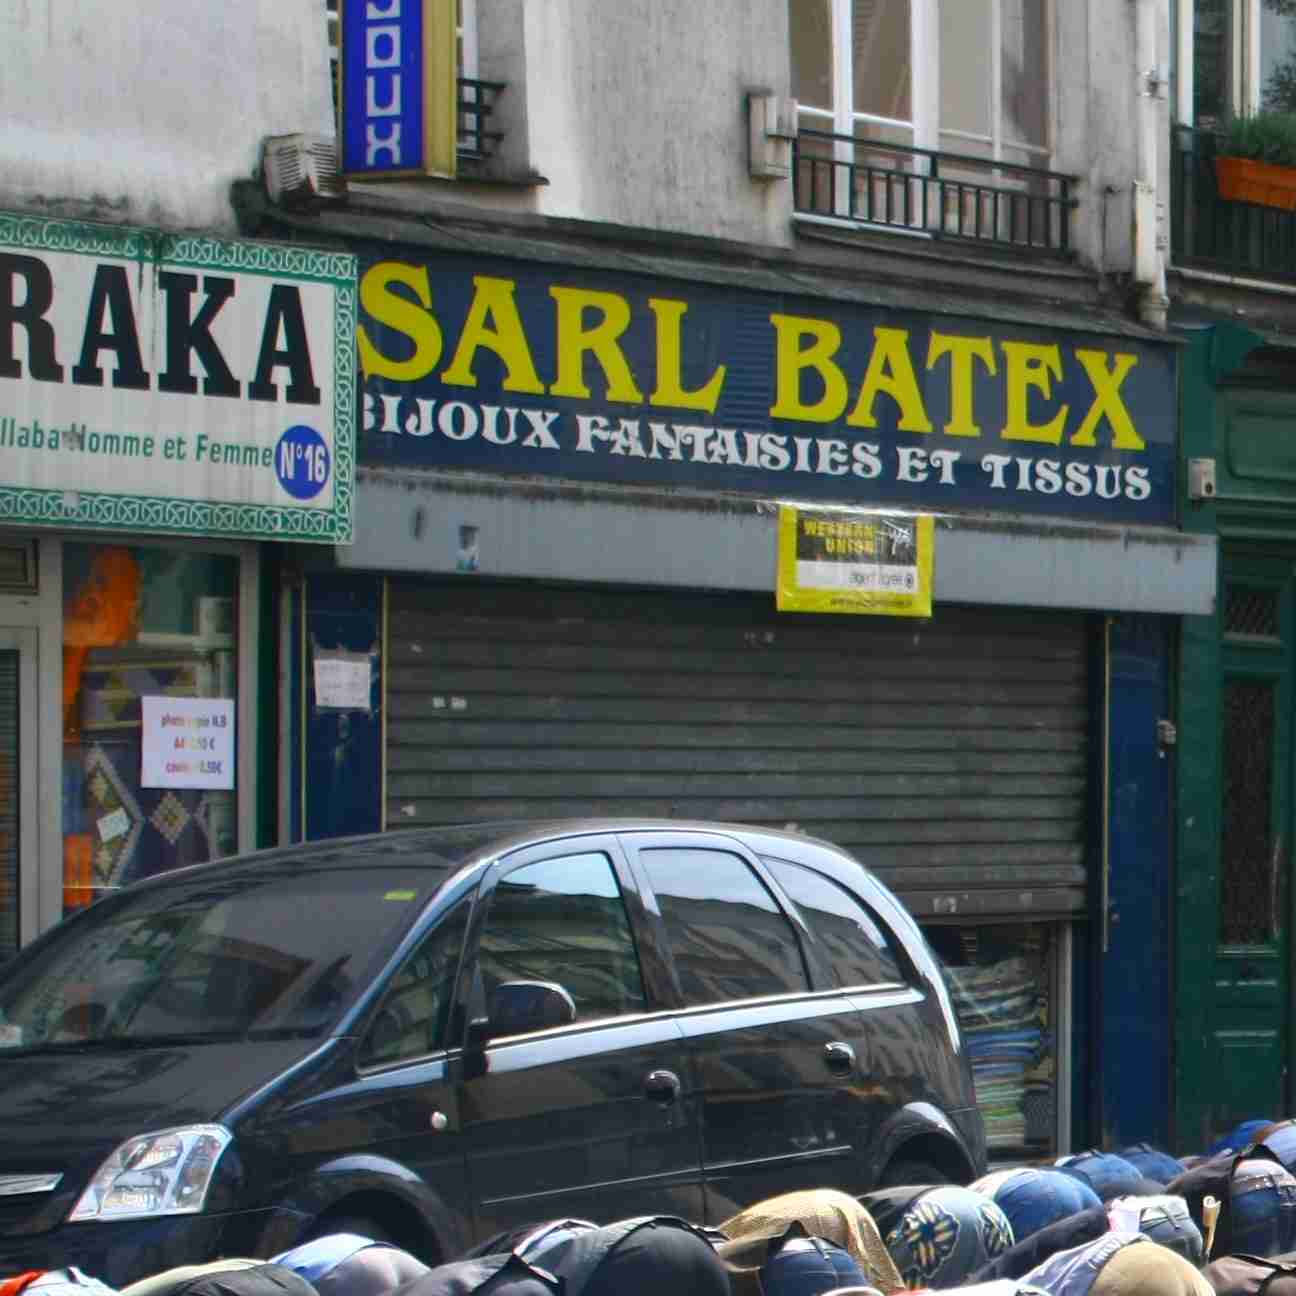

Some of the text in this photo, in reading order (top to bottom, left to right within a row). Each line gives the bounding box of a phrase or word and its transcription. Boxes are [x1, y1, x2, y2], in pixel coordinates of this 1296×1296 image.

[0, 253, 321, 405] RAKA
[355, 261, 1146, 450] SARL BATEX
[163, 430, 188, 460] et
[195, 434, 273, 467] Femme
[280, 440, 326, 483] N°16
[575, 413, 883, 480] FANTAISIES
[896, 446, 962, 486] ET
[981, 454, 1152, 502] TISSUS
